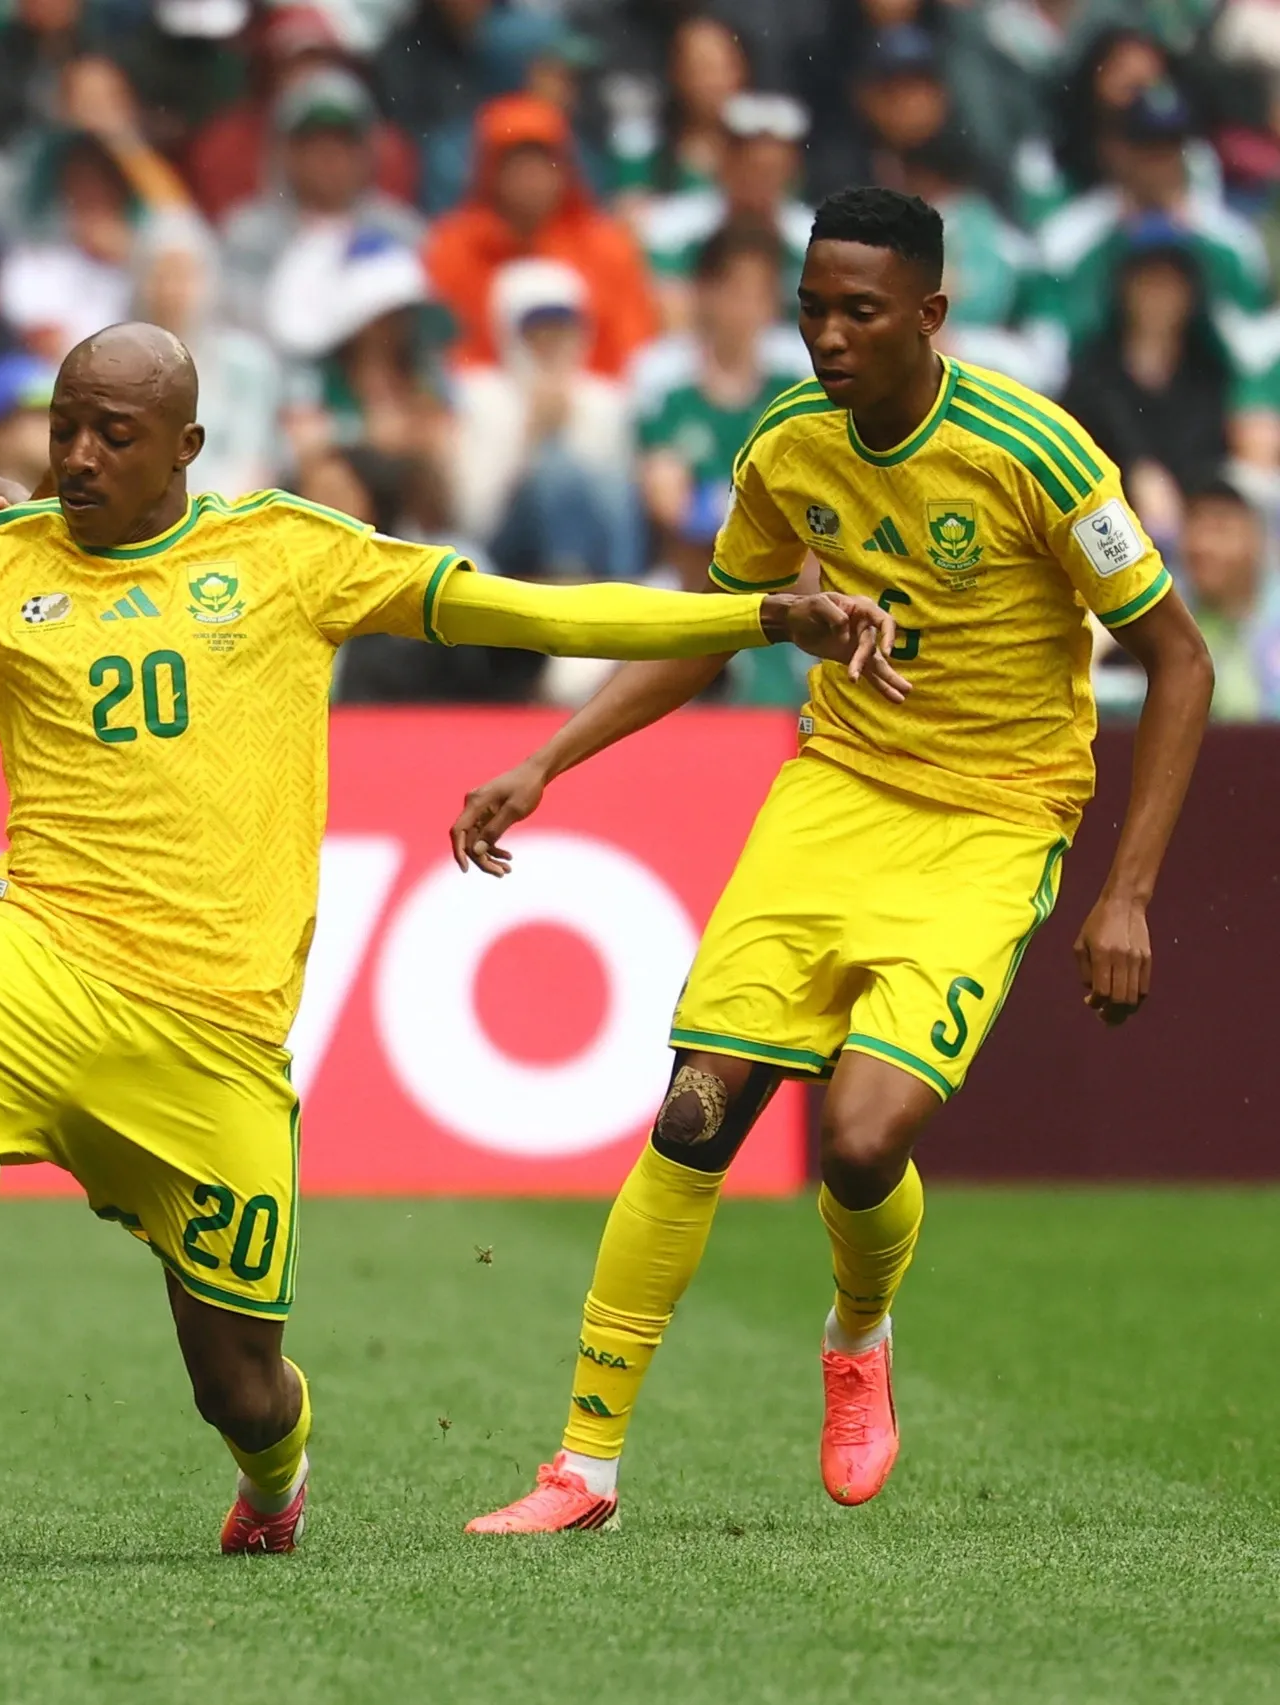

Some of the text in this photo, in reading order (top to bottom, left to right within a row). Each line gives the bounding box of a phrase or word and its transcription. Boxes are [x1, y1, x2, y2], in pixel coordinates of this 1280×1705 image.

[1104, 539, 1130, 560] PEACE
[89, 649, 189, 743] 20
[184, 1183, 279, 1281] 20
